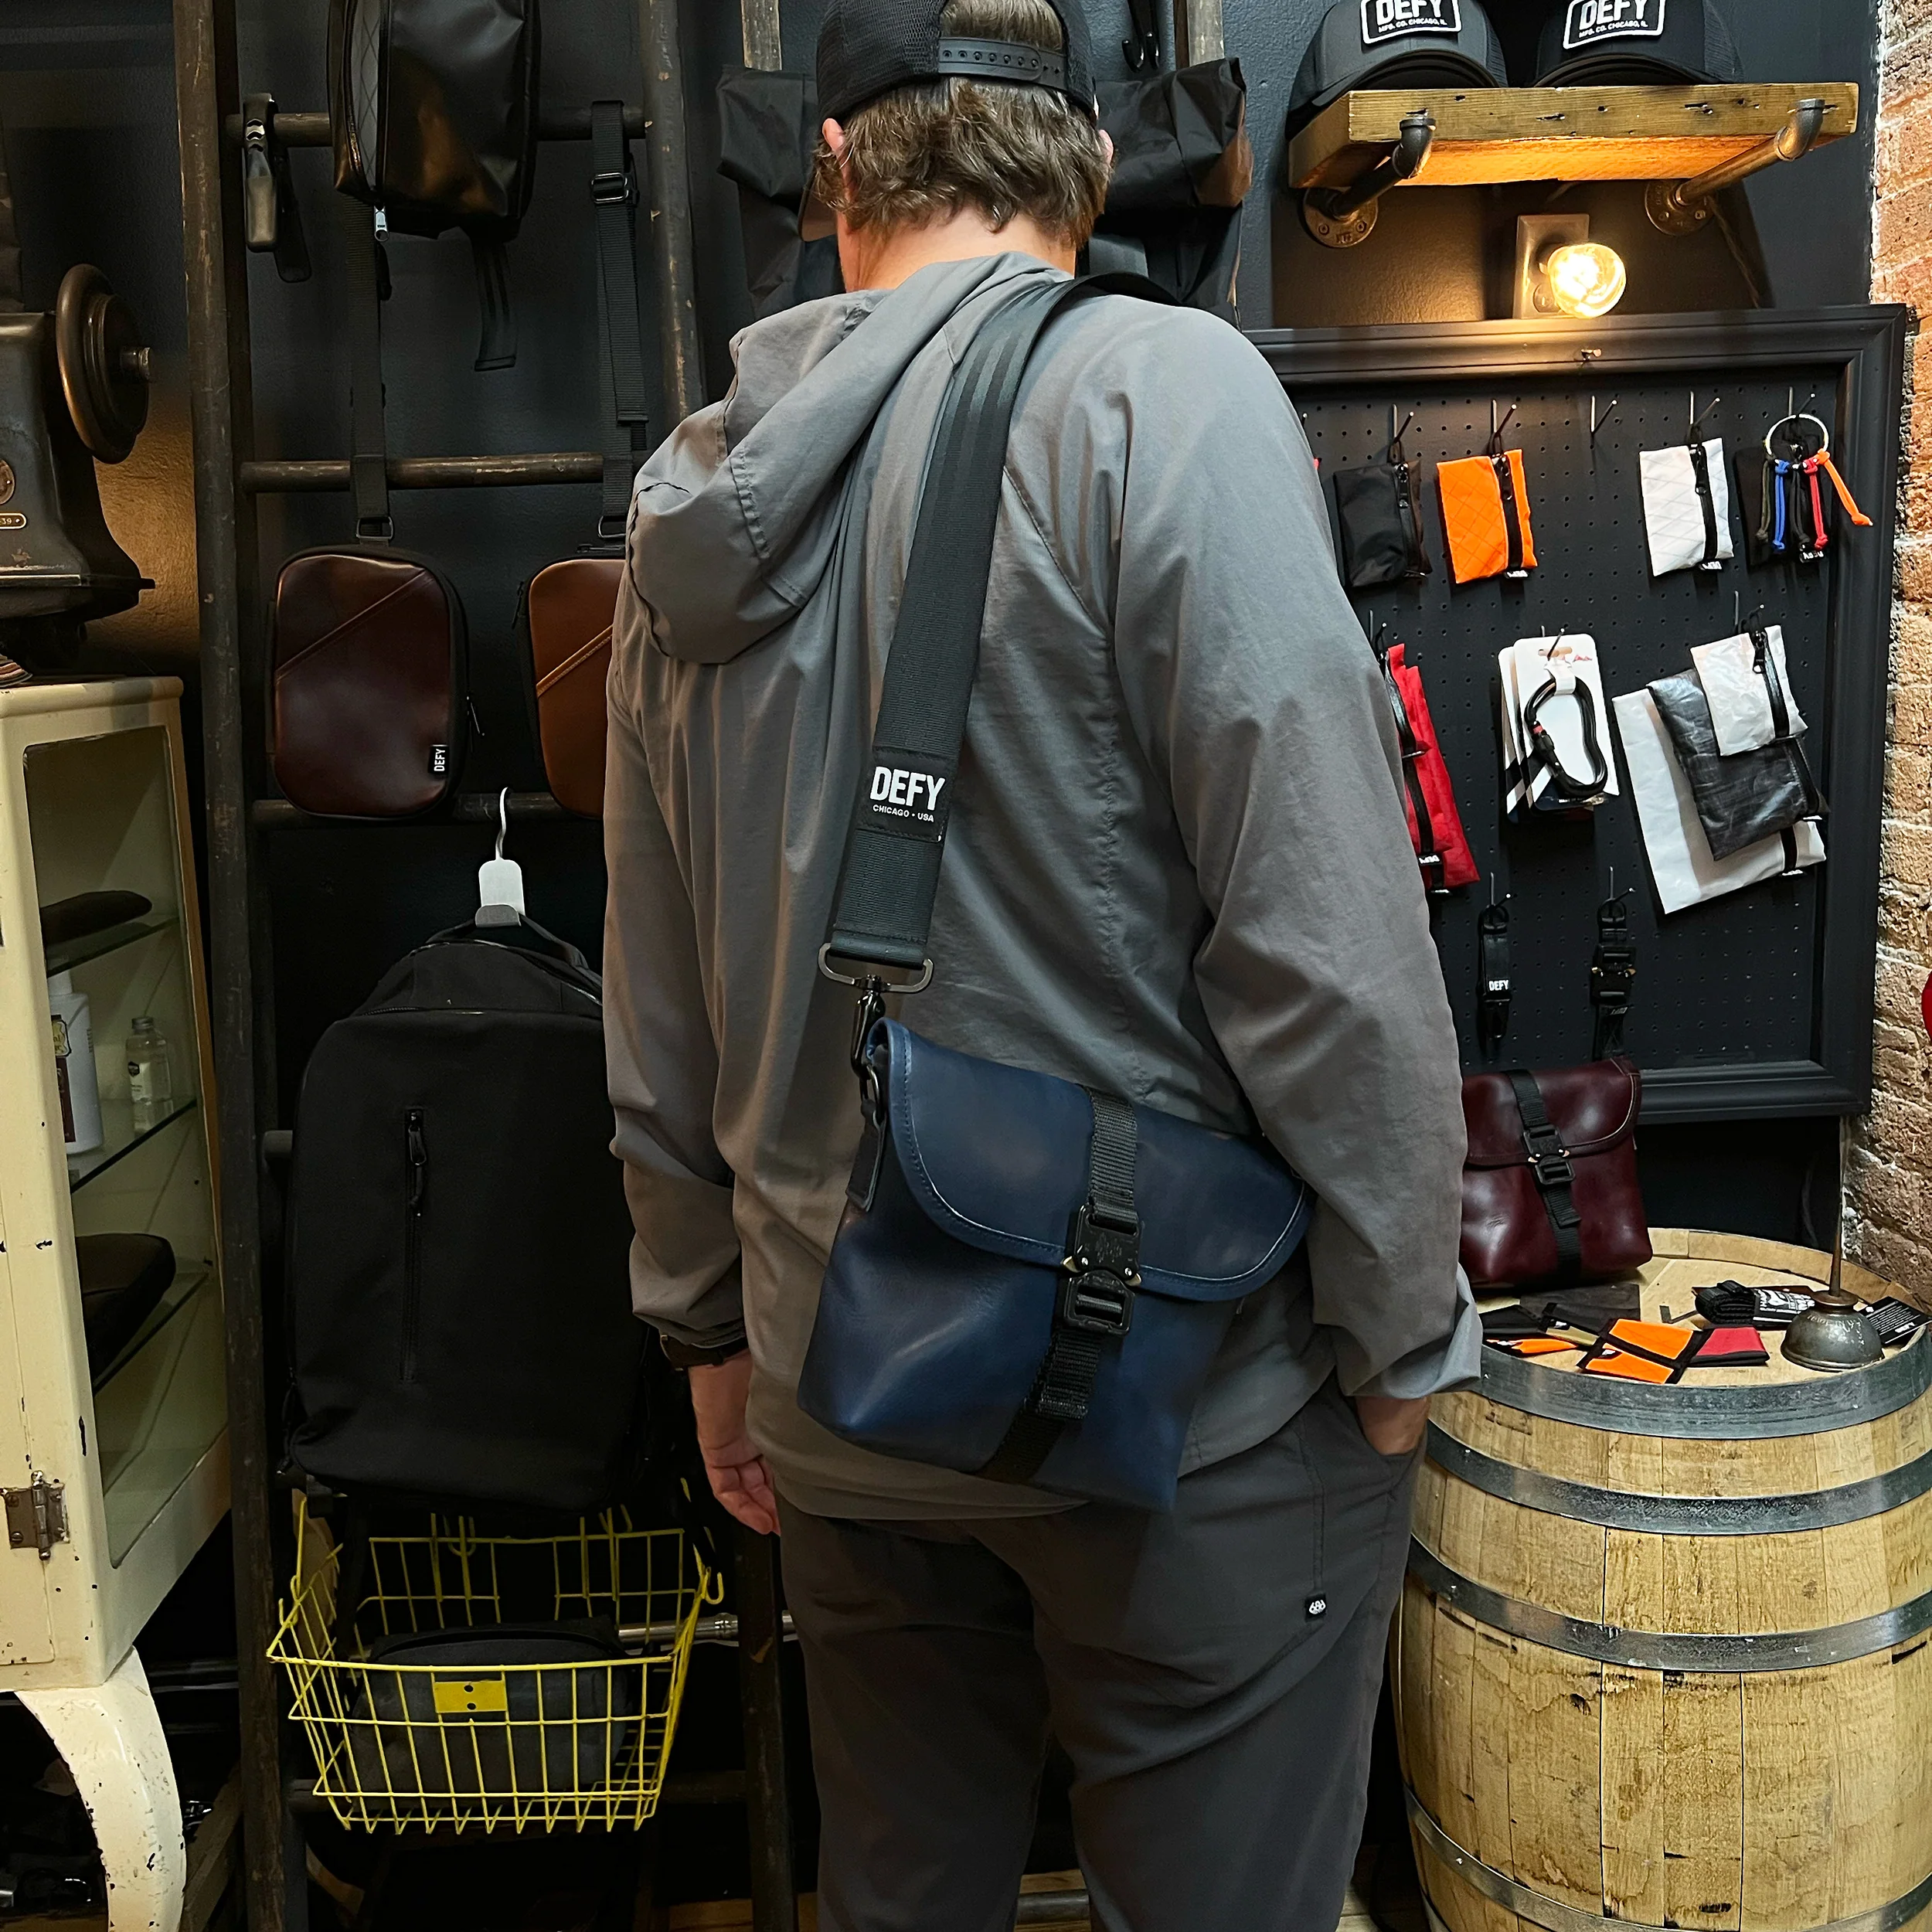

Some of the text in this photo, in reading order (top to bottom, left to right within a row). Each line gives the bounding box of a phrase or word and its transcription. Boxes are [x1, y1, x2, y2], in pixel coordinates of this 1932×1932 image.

[1376, 0, 1441, 26] DEFY
[1579, 0, 1648, 30] DEFY
[434, 748, 446, 772] DEFY
[869, 766, 945, 811] DEFY
[872, 804, 934, 823] CHICAGO USA
[1488, 979, 1509, 992] DEFY
